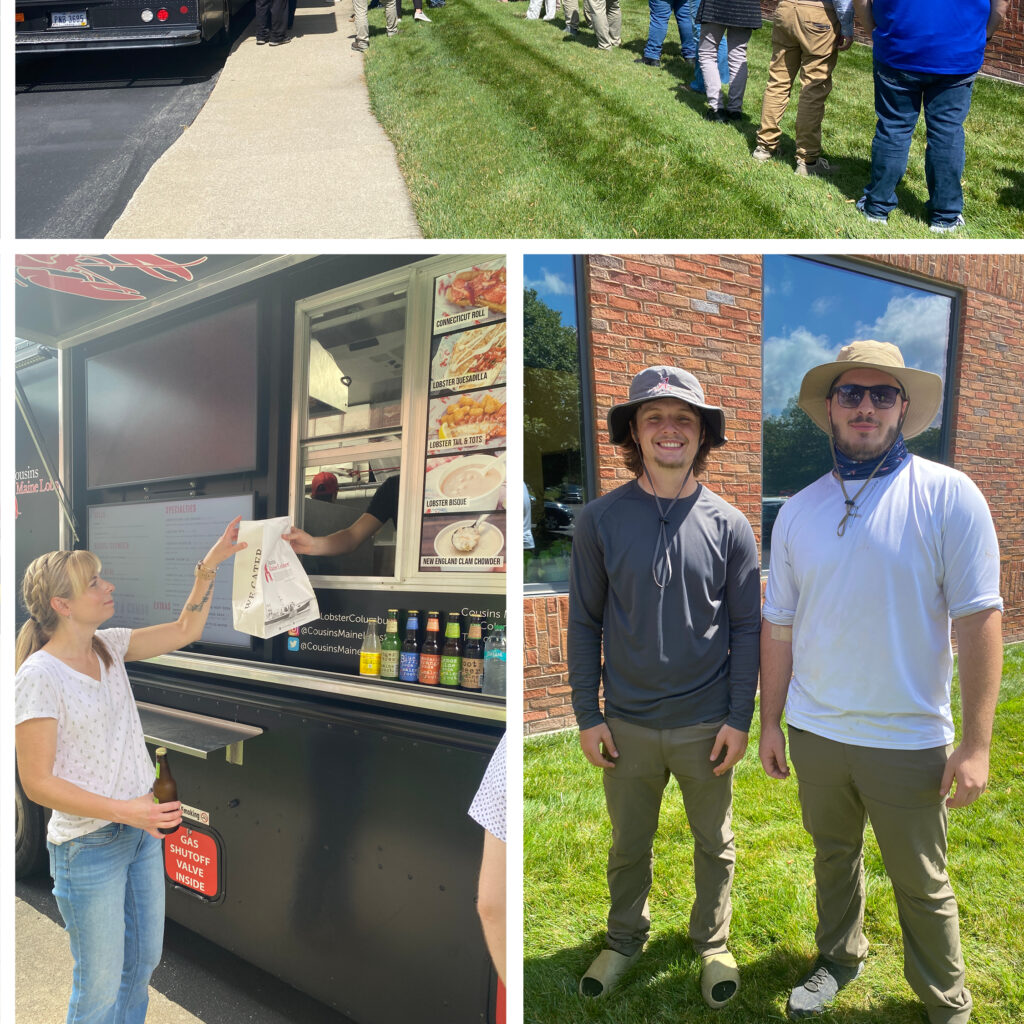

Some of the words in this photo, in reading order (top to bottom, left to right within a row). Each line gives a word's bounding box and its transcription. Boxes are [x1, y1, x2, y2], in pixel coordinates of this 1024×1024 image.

[436, 312, 471, 327] CONNECTICUT
[471, 309, 485, 318] ROLL
[432, 377, 456, 389] LOBSTER
[456, 372, 488, 385] QUESADILLA
[429, 439, 452, 449] LOBSTER
[453, 438, 463, 446] TAIL
[464, 437, 468, 445] &
[469, 435, 483, 444] TOTS
[15, 480, 39, 495] Maine
[426, 498, 448, 508] LOBSTER
[449, 498, 467, 506] BISQUE
[423, 557, 434, 565] NEW
[434, 557, 457, 565] ENGLAND
[458, 557, 473, 565] CLAM
[474, 557, 501, 565] CHOWDER
[244, 592, 256, 609] WE
[250, 548, 263, 589] CATER
[181, 806, 200, 821] Smoking
[180, 835, 199, 848] GAS
[169, 843, 211, 866] SHUTOFF
[176, 858, 204, 878] VALVE
[175, 871, 205, 892] INSIDE
